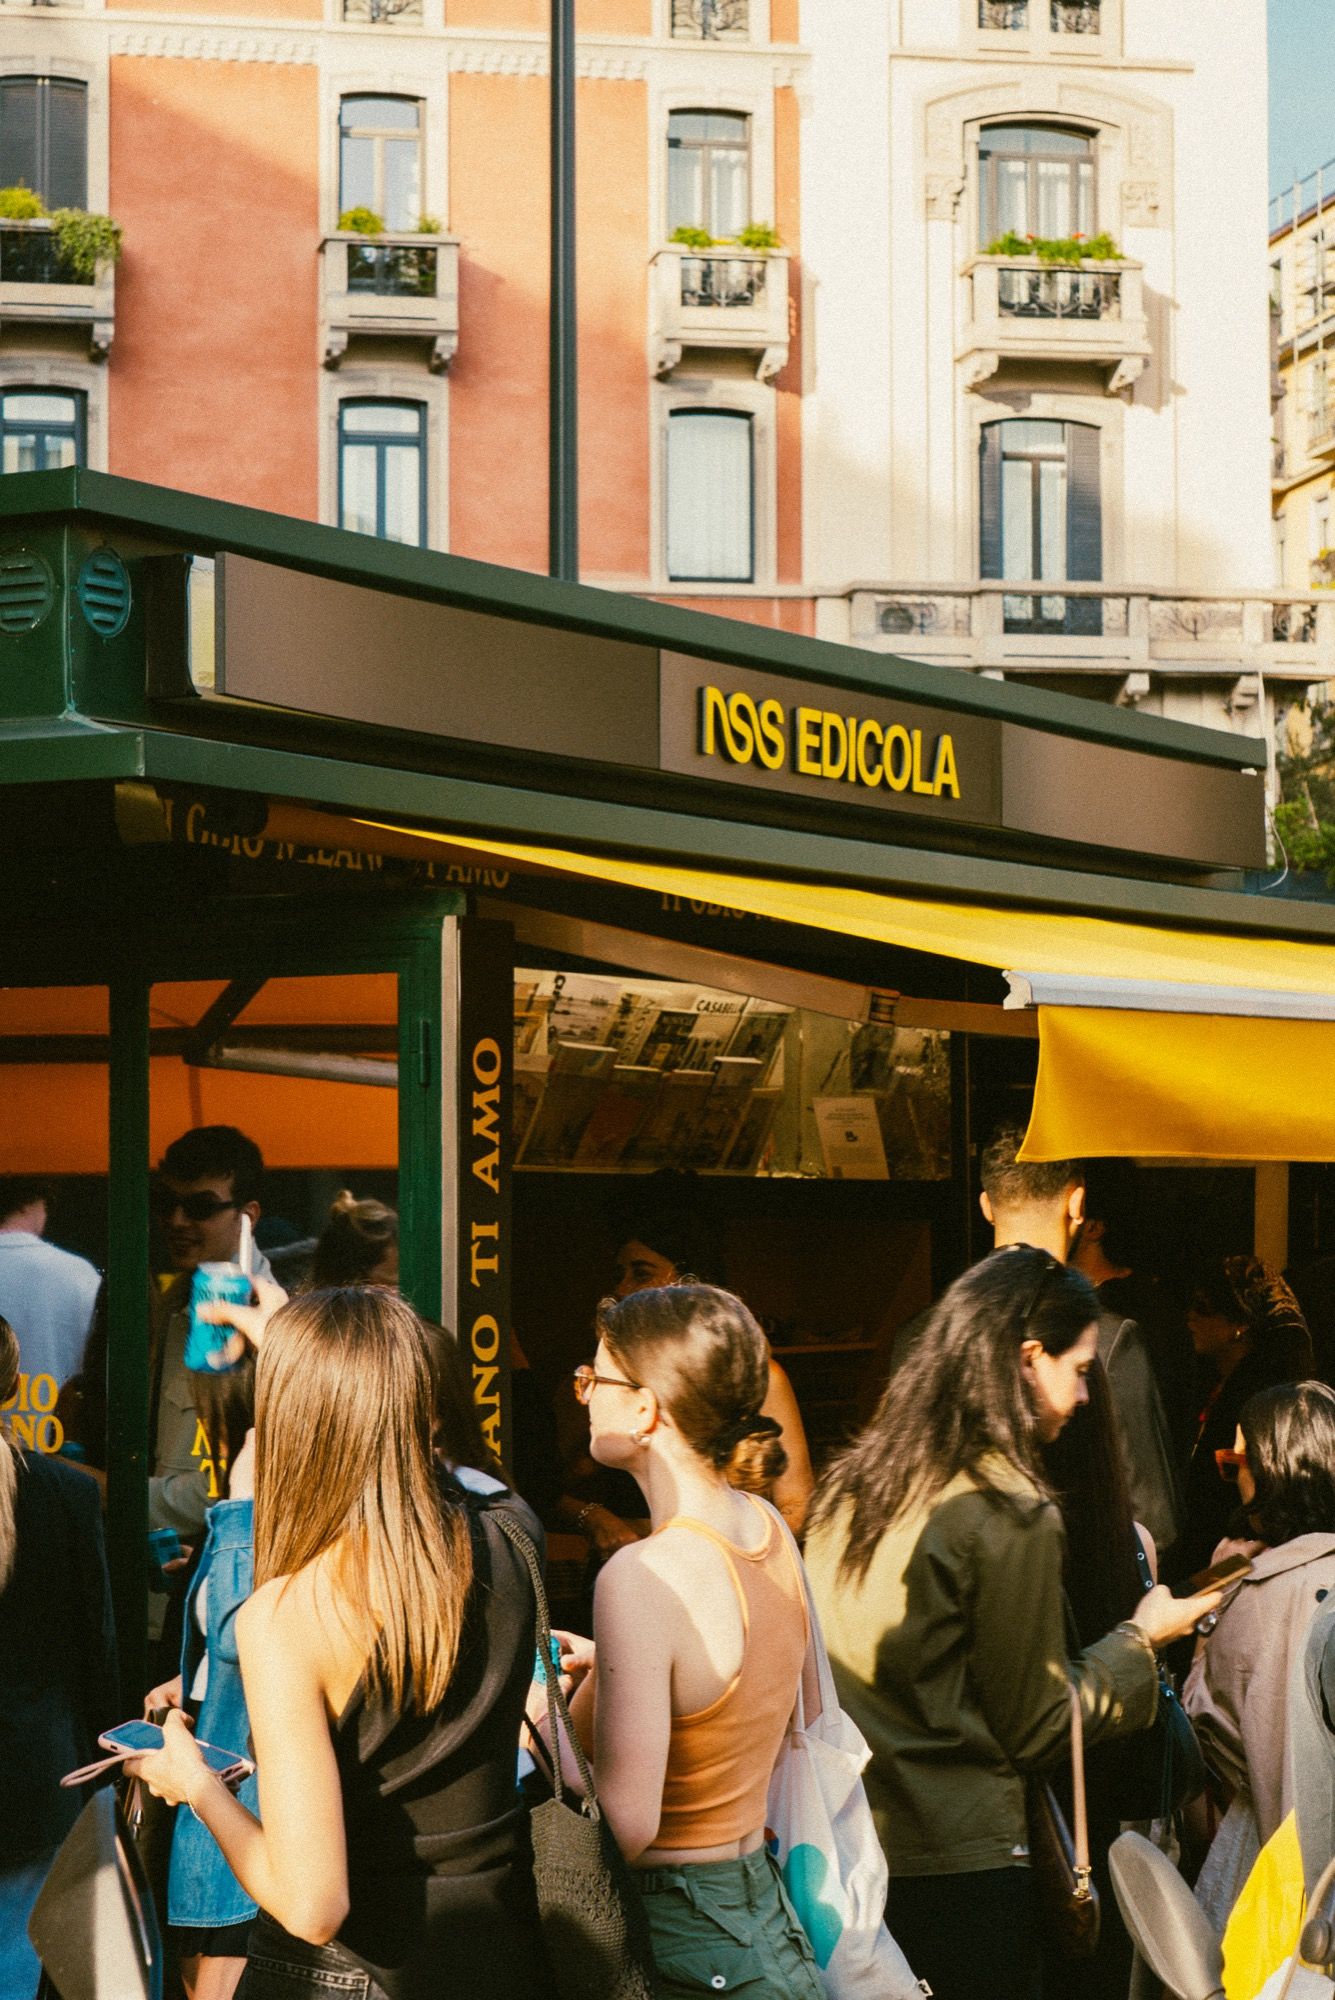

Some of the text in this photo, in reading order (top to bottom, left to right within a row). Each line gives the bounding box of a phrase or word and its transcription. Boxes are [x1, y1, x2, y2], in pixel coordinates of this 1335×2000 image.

[702, 685, 961, 800] NSS EDICOLA
[470, 1037, 502, 1465] ANO TI AMO
[0, 1372, 59, 1413] IO
[0, 1414, 65, 1454] NO
